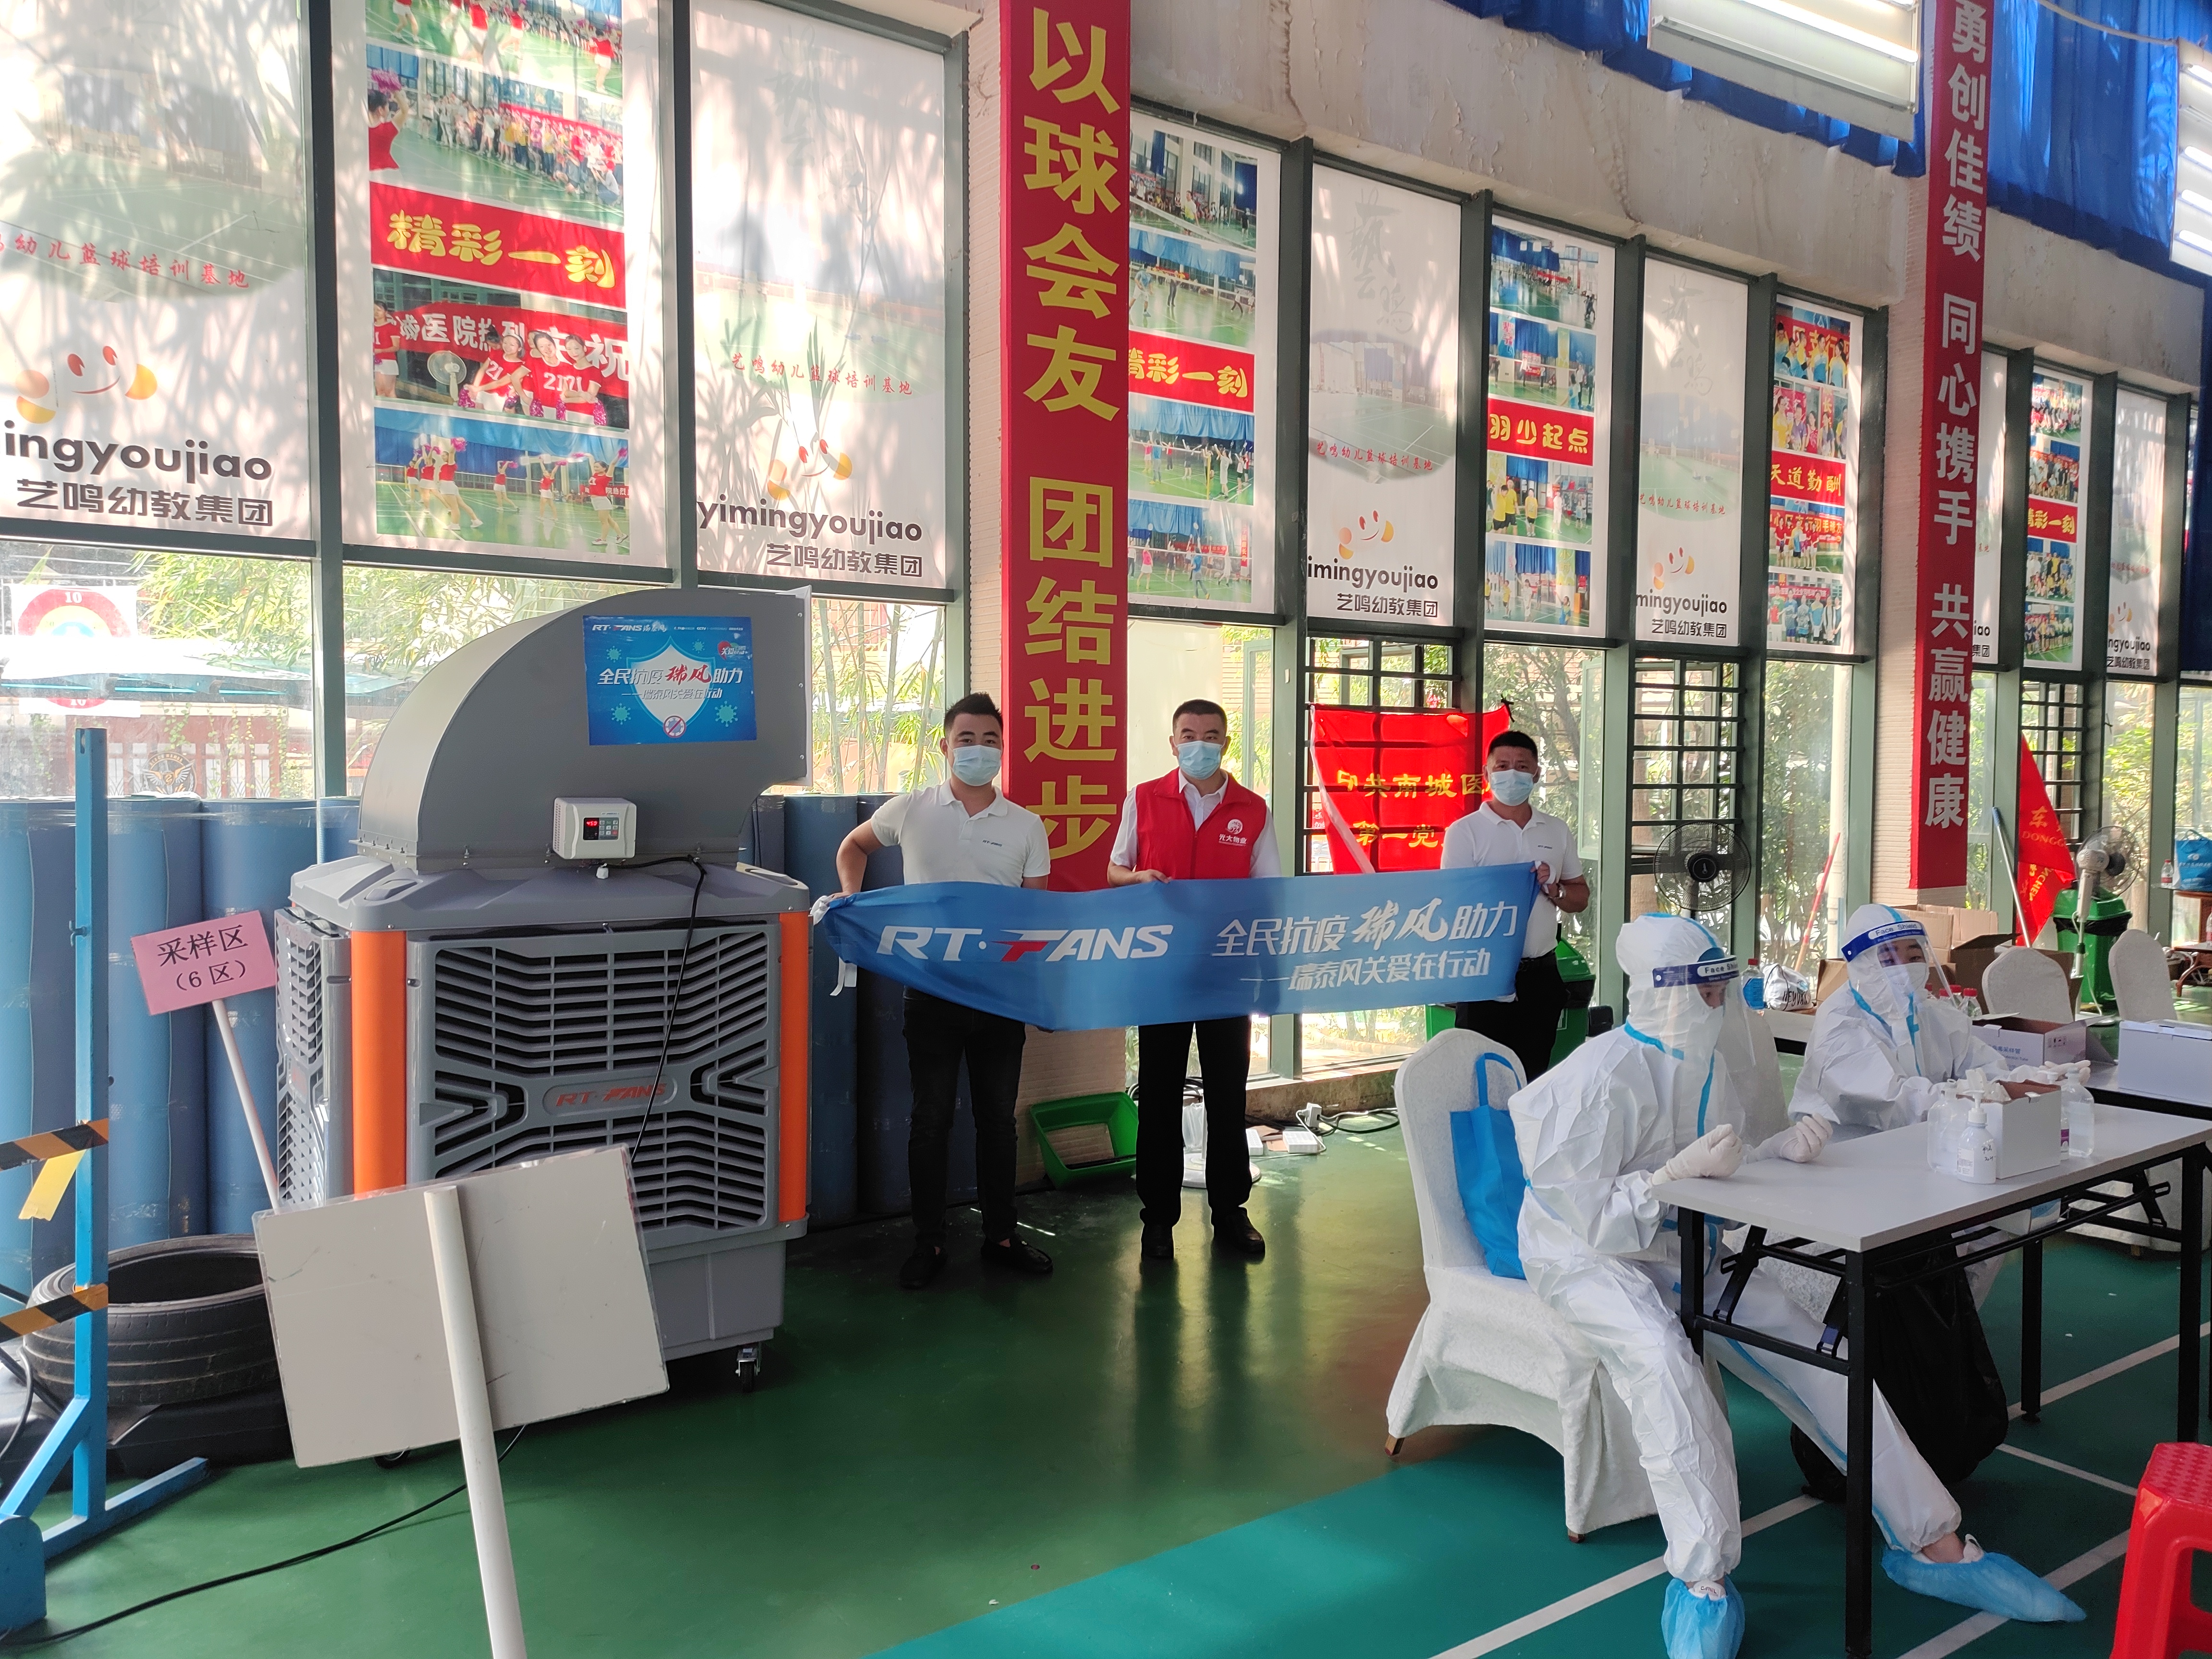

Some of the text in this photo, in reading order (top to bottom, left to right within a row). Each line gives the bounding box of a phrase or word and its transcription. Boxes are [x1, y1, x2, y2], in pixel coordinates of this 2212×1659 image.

[387, 209, 616, 288] 精彩一刻
[485, 360, 504, 381] 21
[731, 352, 913, 396] 艺鸣幼儿篮球培训基地
[1925, 0, 1986, 829] 勇创佳绩 同心携手 共赢健康
[1023, 6, 1120, 860] 以球会友 团结进步
[0, 420, 273, 484] ingyoujiao
[1316, 442, 1434, 471] 艺鸣幼儿篮球培训基地
[1770, 464, 1842, 497] 天道勤酬
[17, 478, 273, 527] 艺鸣幼教集团
[697, 494, 922, 545] yimingyoujiao
[767, 542, 923, 578] 艺鸣幼教集团
[65, 591, 83, 603] 10
[1337, 592, 1438, 618] 艺鸣幼教集团
[1651, 617, 1728, 639] 艺鸣幼教集团
[2107, 655, 2150, 670] 艺鸣幼教集团
[1219, 834, 1247, 844] 光大物业
[1353, 821, 1446, 848] 第一党
[157, 924, 249, 967] 采样区
[1876, 927, 1894, 936] Face
[1705, 966, 1725, 974] Face
